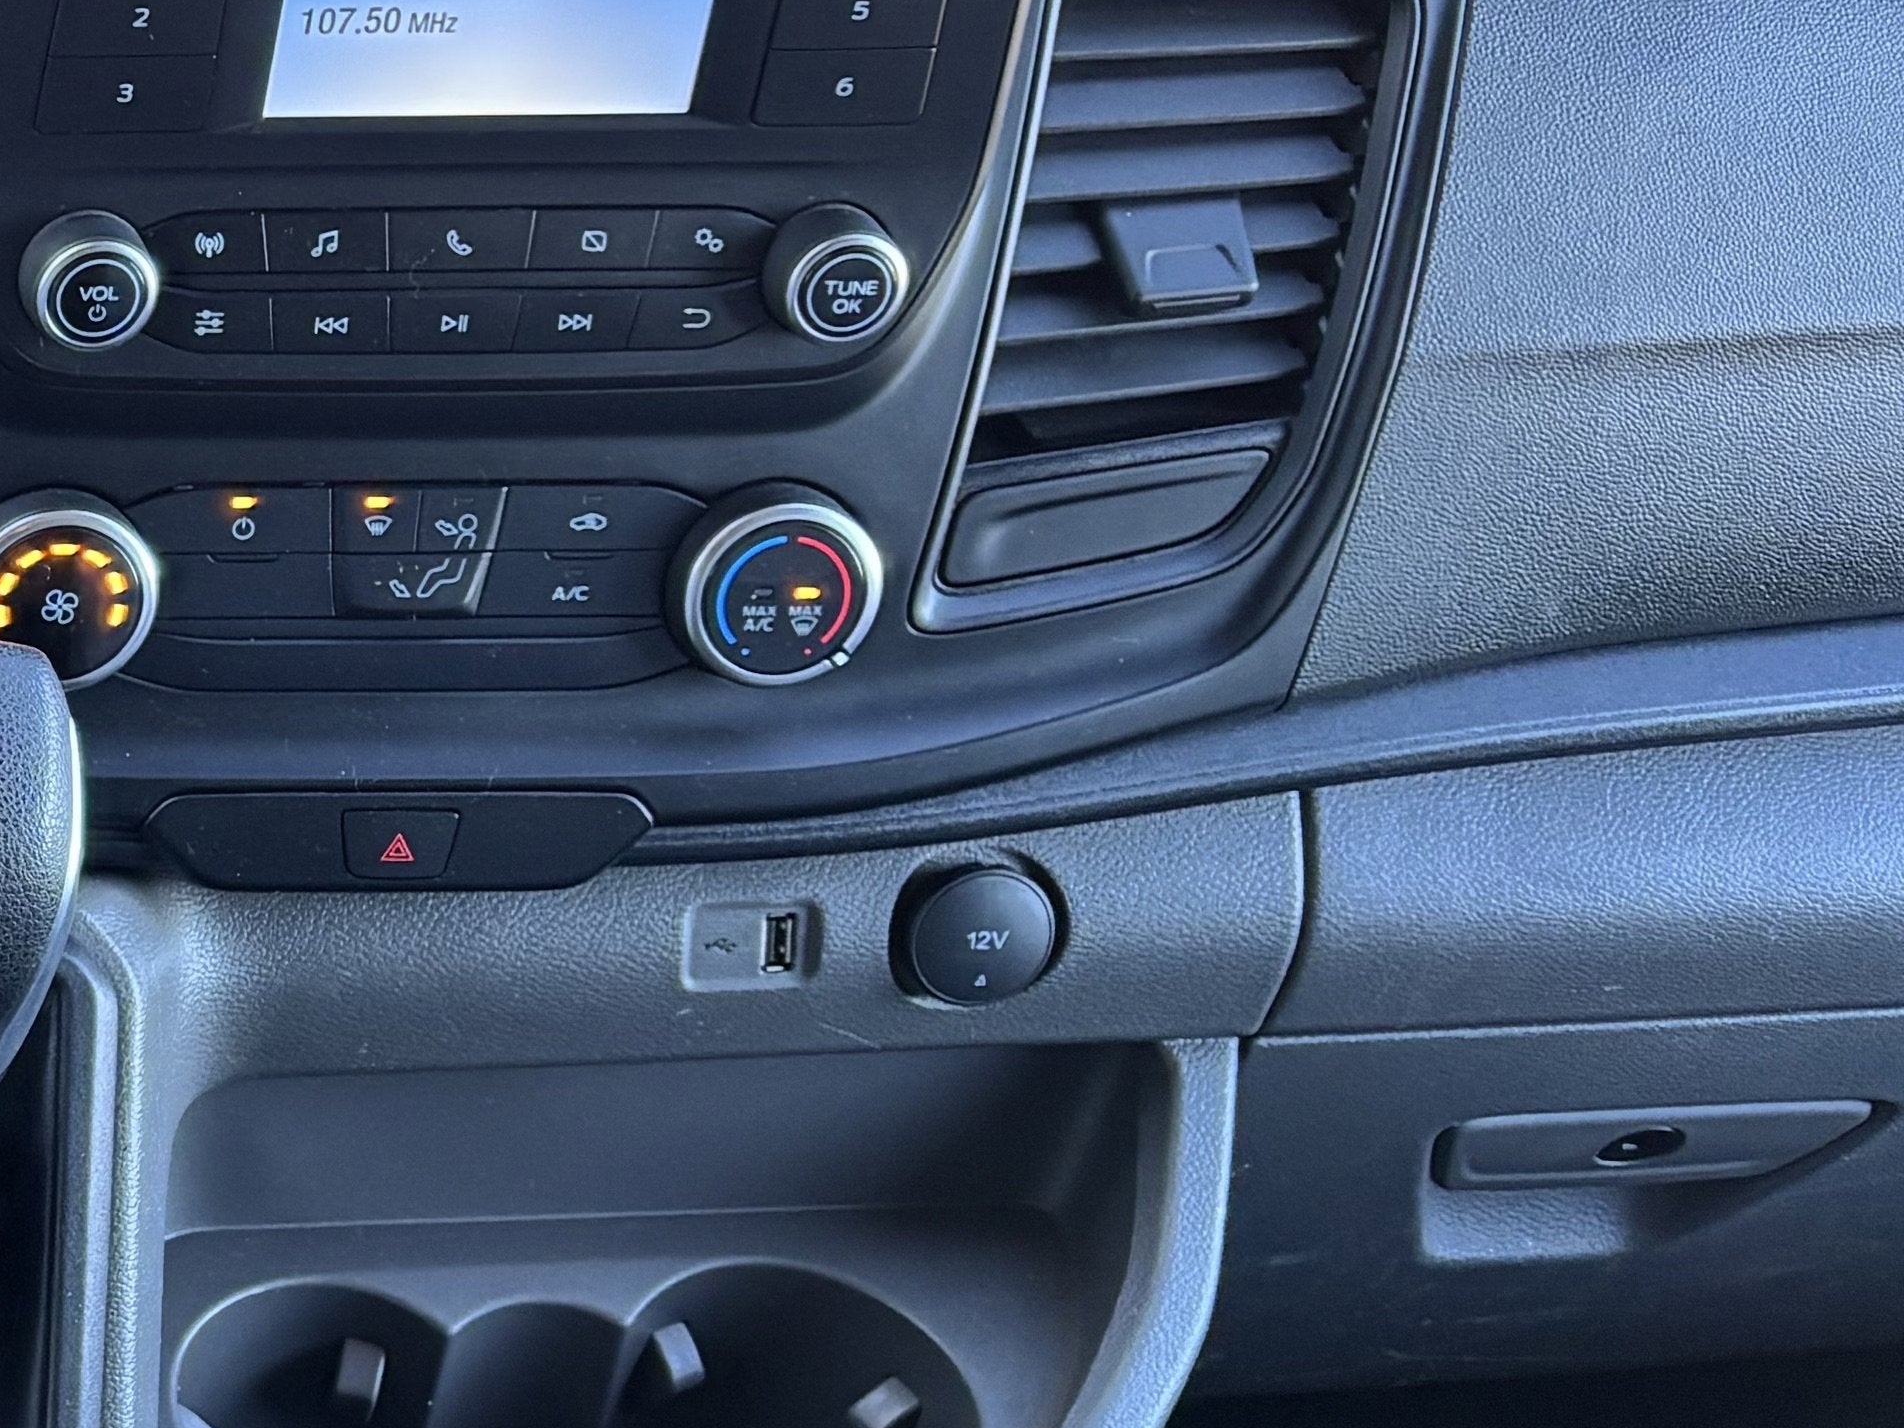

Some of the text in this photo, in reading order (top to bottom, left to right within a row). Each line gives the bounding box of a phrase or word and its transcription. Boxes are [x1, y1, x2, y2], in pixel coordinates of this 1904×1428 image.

[132, 8, 150, 27] 2
[851, 0, 870, 21] 5
[301, 6, 459, 35] 107.50 MHz
[116, 83, 134, 103] 3
[835, 77, 854, 97] 6
[79, 285, 120, 302] VOL
[824, 279, 880, 297] TUNE
[832, 298, 863, 315] OK
[551, 584, 591, 602] A/C
[742, 605, 777, 617] MAX
[788, 604, 823, 618] MAX
[743, 618, 774, 633] A/C
[965, 929, 1011, 952] 12V
